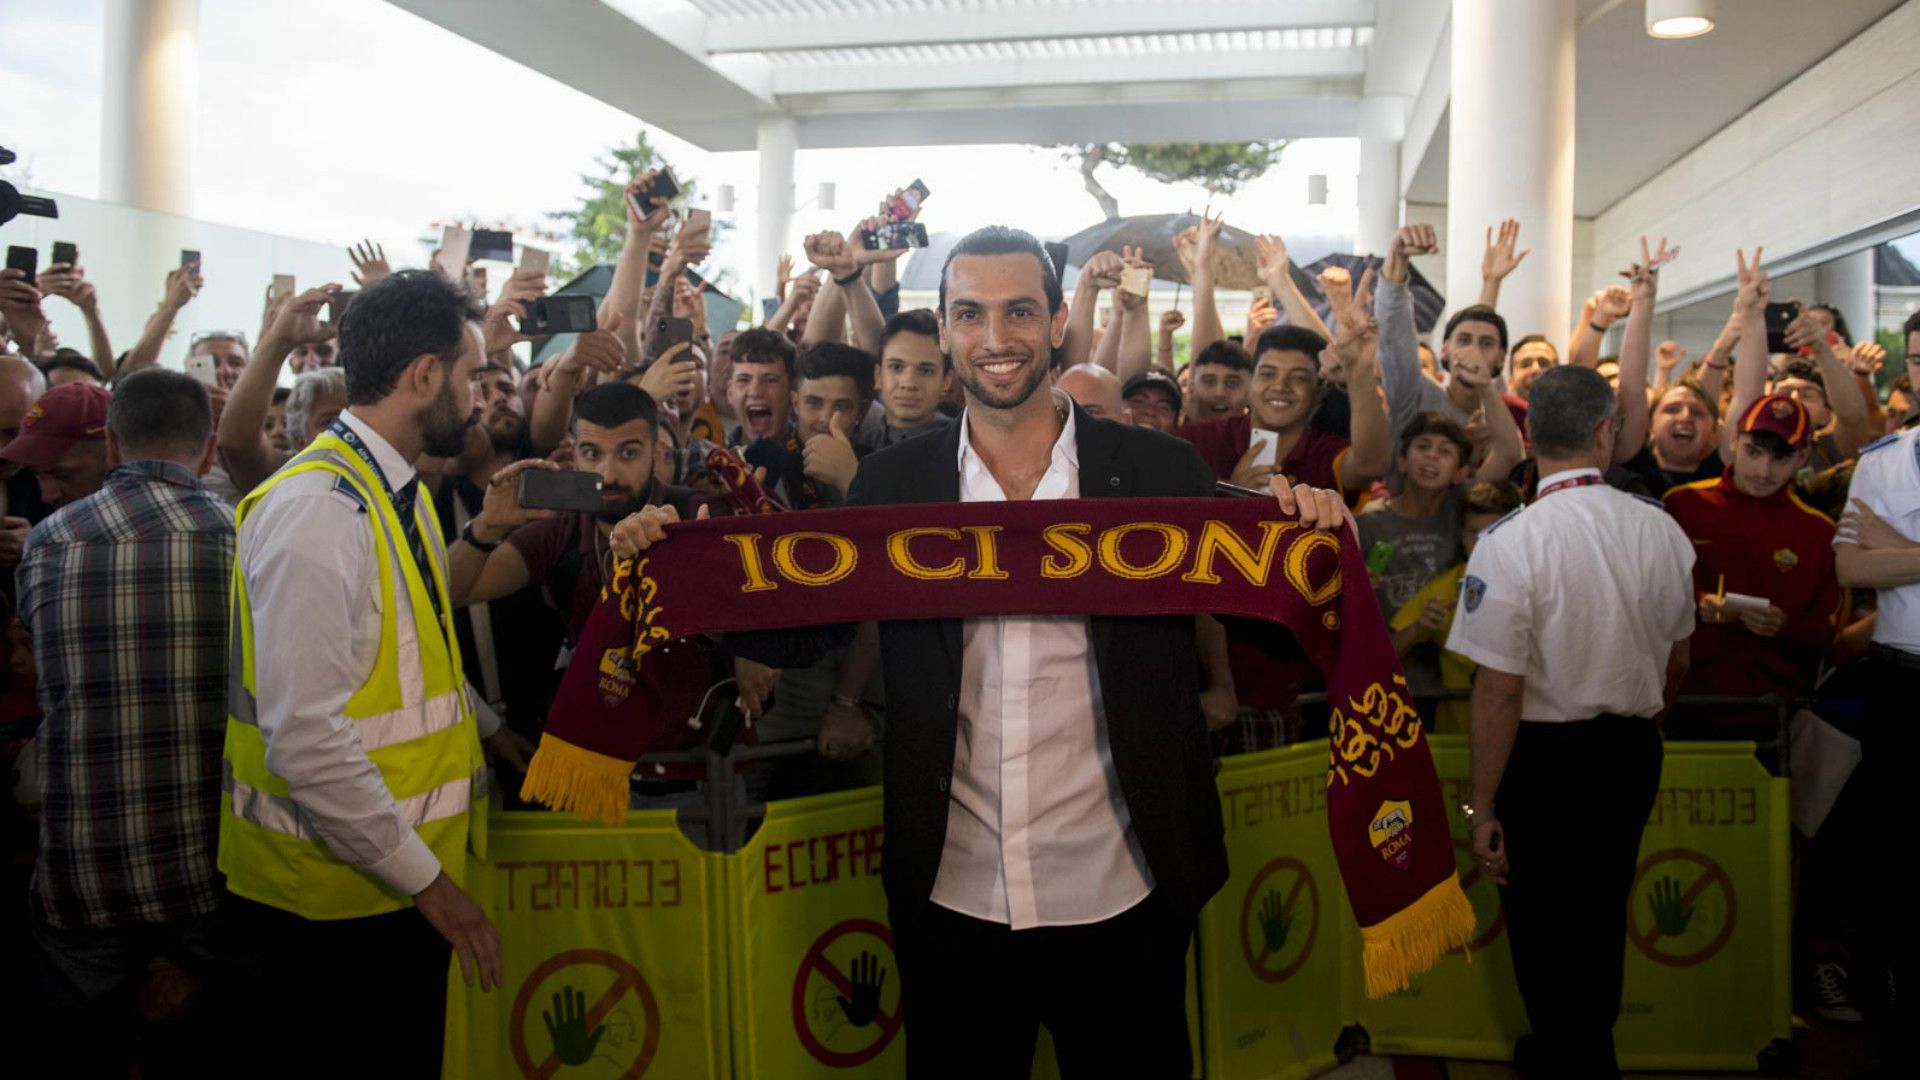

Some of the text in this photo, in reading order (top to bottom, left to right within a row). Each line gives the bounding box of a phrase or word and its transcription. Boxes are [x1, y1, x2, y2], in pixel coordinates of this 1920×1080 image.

[722, 529, 858, 594] IO
[886, 526, 1010, 582] CI
[1381, 833, 1412, 861] ROMA
